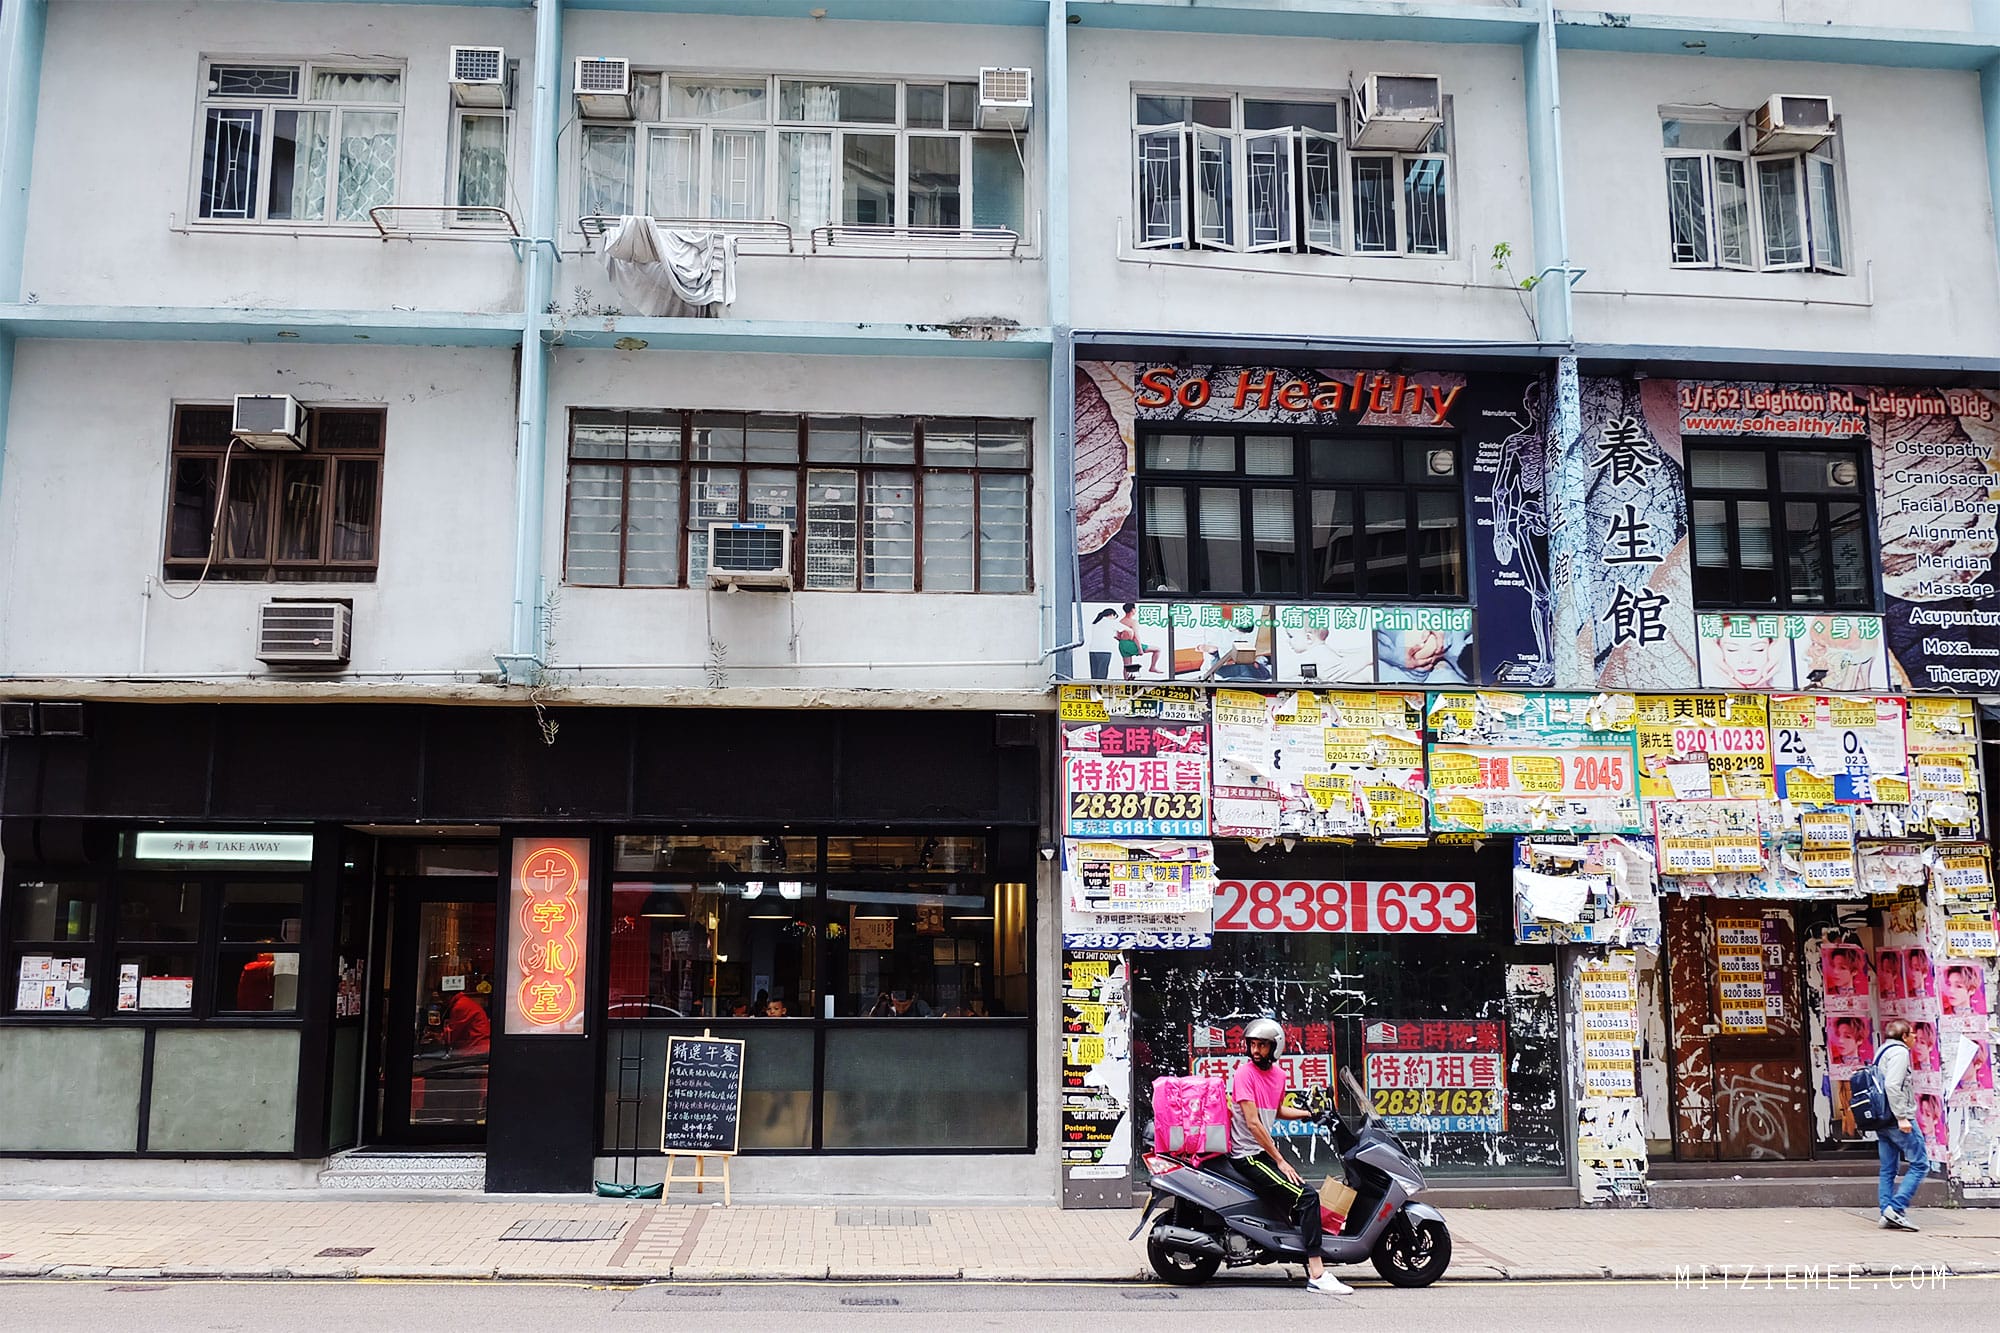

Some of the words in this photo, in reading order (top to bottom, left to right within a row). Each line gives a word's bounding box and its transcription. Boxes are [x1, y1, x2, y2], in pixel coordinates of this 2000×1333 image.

[1138, 367, 1211, 410] So
[1232, 369, 1467, 426] Healthy
[1681, 386, 1740, 413] 1/F,62
[1745, 387, 1826, 417] Leighton
[1870, 392, 1946, 420] Leigyinn
[1950, 395, 1993, 423] Bldg
[1686, 416, 1866, 435] www.sohealthy.hk
[1895, 440, 1992, 460] Osteopathy
[1894, 470, 1999, 487] Craniosacral
[1900, 498, 1948, 512] Facial
[1954, 500, 1998, 515] Bone
[1590, 417, 1671, 648] 養生館
[1907, 524, 1996, 542] Alignment
[1916, 555, 1991, 570] Meridian
[1918, 581, 1994, 598] Massage
[1369, 608, 1412, 630] Pain
[1416, 608, 1472, 630] Relief
[1926, 665, 2000, 687] Therapy
[1167, 689, 1190, 699] 2299
[1062, 707, 1083, 717] 6335
[1085, 708, 1107, 718] 5525
[1165, 711, 1186, 719] 9320
[1218, 713, 1239, 721] 6976
[1298, 714, 1318, 723] 3227
[1355, 715, 1375, 723] 2181
[1457, 718, 1473, 726] 068
[1794, 718, 1813, 727] 327
[1854, 716, 1874, 724] 2299
[1327, 752, 1348, 760] 6204
[1399, 757, 1419, 765] 9107
[1573, 756, 1624, 791] 2045
[1922, 772, 1940, 782] 8200
[1943, 772, 1961, 783] 6835
[1434, 775, 1454, 785] 6473
[1456, 775, 1477, 784] 0068
[1071, 792, 1204, 819] 28381633
[1112, 821, 1154, 834] 6181
[1160, 821, 1203, 834] 6119
[1236, 828, 1257, 836] 2395
[1807, 831, 1826, 840] 8200
[1829, 831, 1848, 839] 6835
[216, 841, 245, 851] TAKE
[247, 842, 281, 852] AWAY
[1670, 856, 1689, 865] 8200
[1692, 856, 1711, 866] 6835
[1717, 854, 1736, 863] 8200
[1739, 854, 1757, 863] 6835
[1808, 869, 1827, 877] 8200
[1830, 868, 1850, 877] 6835
[1944, 876, 1961, 886] 8200
[1965, 875, 1984, 885] 6835
[1214, 880, 1476, 933] 28381633
[527, 859, 568, 1015] 十字冰室
[1720, 935, 1738, 944] 8200
[1740, 935, 1759, 944] 6835
[1951, 938, 1969, 947] 8200
[1971, 938, 1993, 948] 6835
[1085, 951, 1099, 960] SHIT
[1721, 962, 1740, 971] 8200
[1742, 962, 1760, 971] 6835
[1584, 990, 1627, 998] 81003413
[1723, 989, 1742, 998] 8200
[1744, 989, 1762, 998] 6835
[1586, 1019, 1629, 1028] 81003413
[1725, 1016, 1744, 1025] 8200
[1745, 1016, 1764, 1025] 6835
[1398, 1022, 1499, 1051] 金時物業
[1587, 1049, 1631, 1057] 81003413
[1371, 1056, 1498, 1087] 特約租售
[1068, 1078, 1082, 1086] VIP
[1588, 1078, 1632, 1087] 81003413
[1374, 1089, 1501, 1115] 28381633
[1086, 1111, 1099, 1120] SHIT
[1064, 1124, 1096, 1132] Postering
[1384, 1117, 1409, 1130] 先生
[1069, 1132, 1083, 1140] VIP
